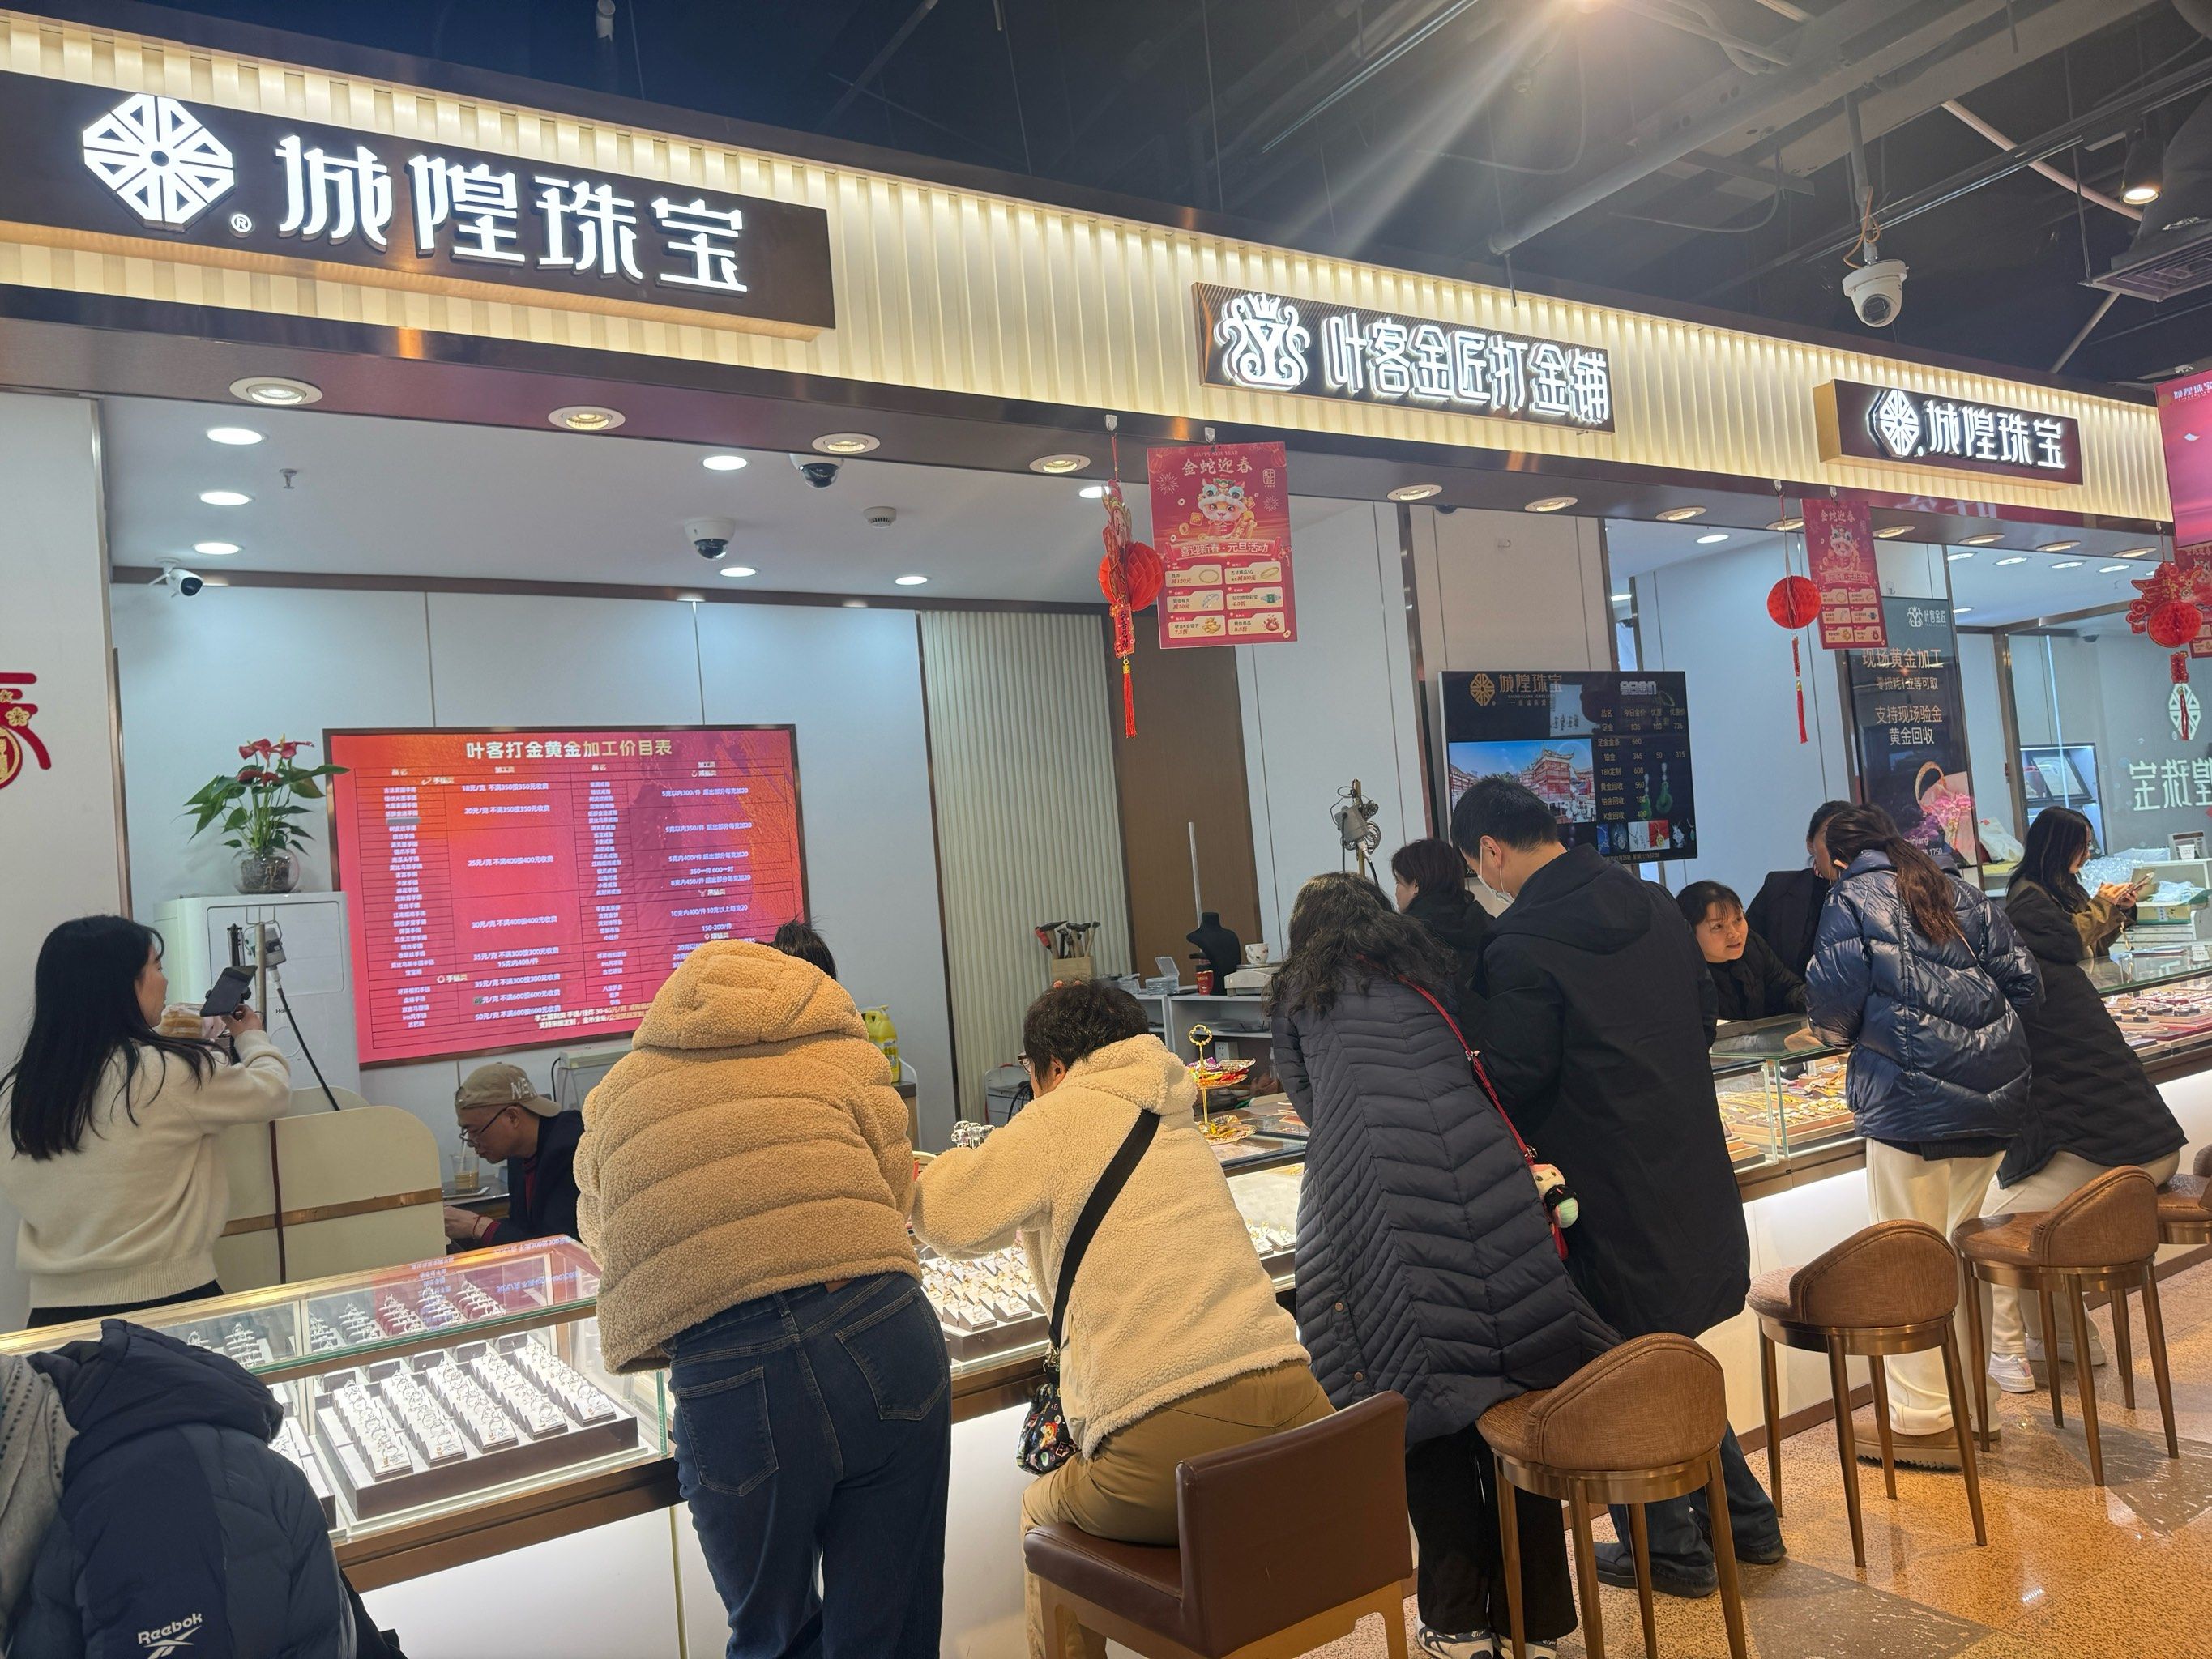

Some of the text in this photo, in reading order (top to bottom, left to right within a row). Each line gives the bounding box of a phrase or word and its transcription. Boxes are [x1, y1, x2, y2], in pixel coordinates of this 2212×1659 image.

[275, 134, 750, 294] 城隍珠宝
[1322, 313, 1610, 424] 叶客金匠打金铺
[1926, 399, 2066, 470] 城隍珠宝
[1182, 457, 1253, 476] 金蛇迎春
[1862, 647, 1944, 669] 现场黄金加工
[1499, 673, 1563, 693] 城隍珠宝
[1875, 705, 1943, 724] 支持现场验金
[1889, 727, 1935, 746] 黄金回收
[466, 739, 673, 760] 叶客打金黄金加工价目表
[137, 1613, 203, 1644] Reebok
